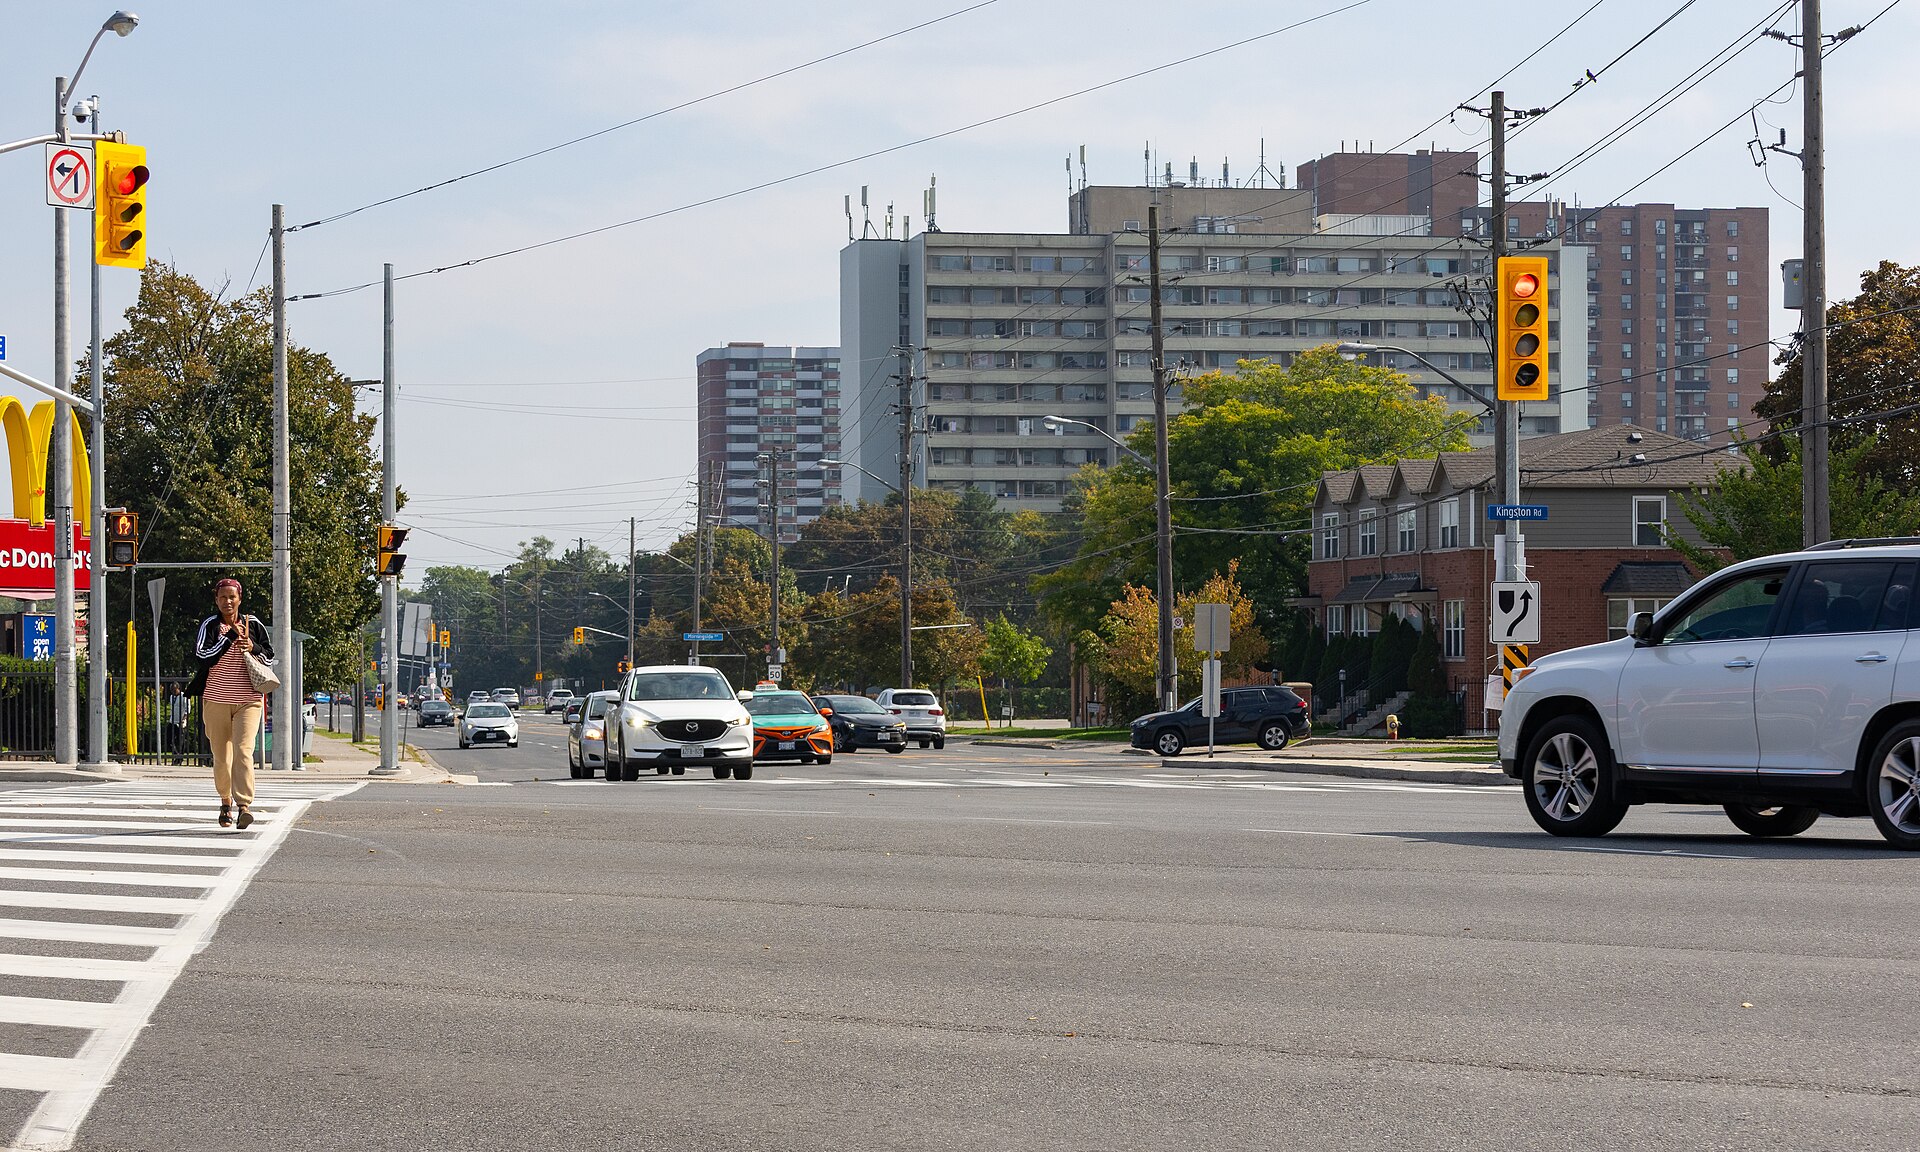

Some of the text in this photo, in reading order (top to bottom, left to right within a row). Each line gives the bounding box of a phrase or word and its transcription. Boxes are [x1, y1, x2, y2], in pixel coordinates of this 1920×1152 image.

[1496, 506, 1542, 518] Kingston Rd
[0, 547, 91, 570] cDond's
[33, 638, 50, 647] open
[33, 645, 50, 661] 24
[770, 671, 781, 679] 50
